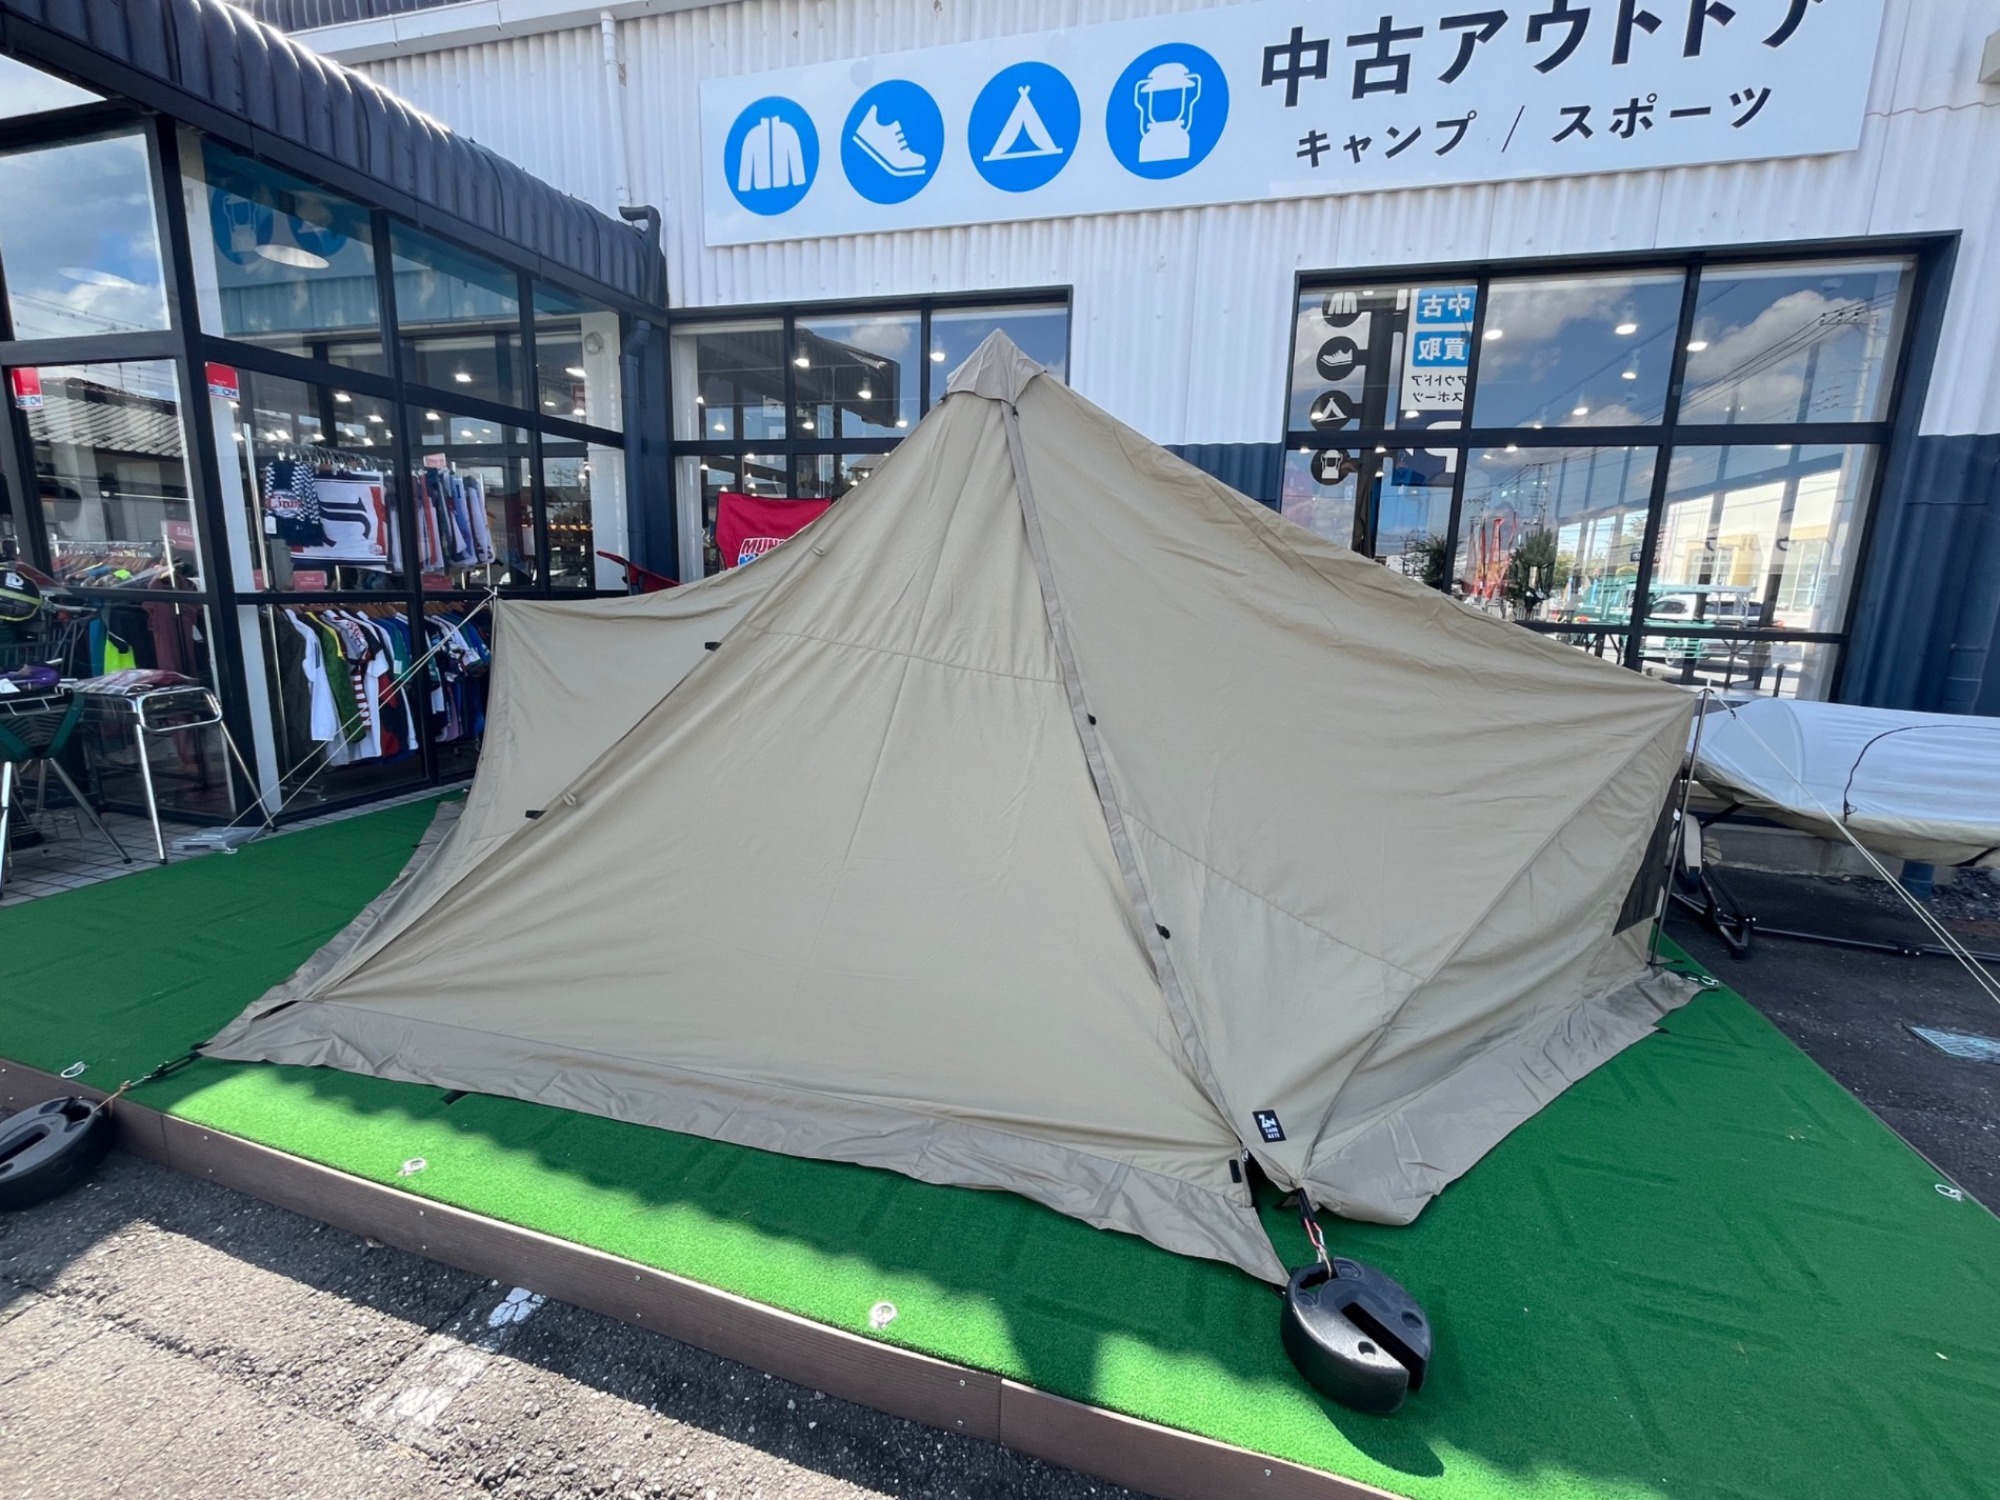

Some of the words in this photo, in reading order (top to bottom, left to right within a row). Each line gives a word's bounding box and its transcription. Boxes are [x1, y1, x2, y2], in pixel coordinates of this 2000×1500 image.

[1296, 109, 1478, 168] キャンプ
[1550, 86, 1772, 144] スポーツ
[740, 538, 787, 555] MUN
